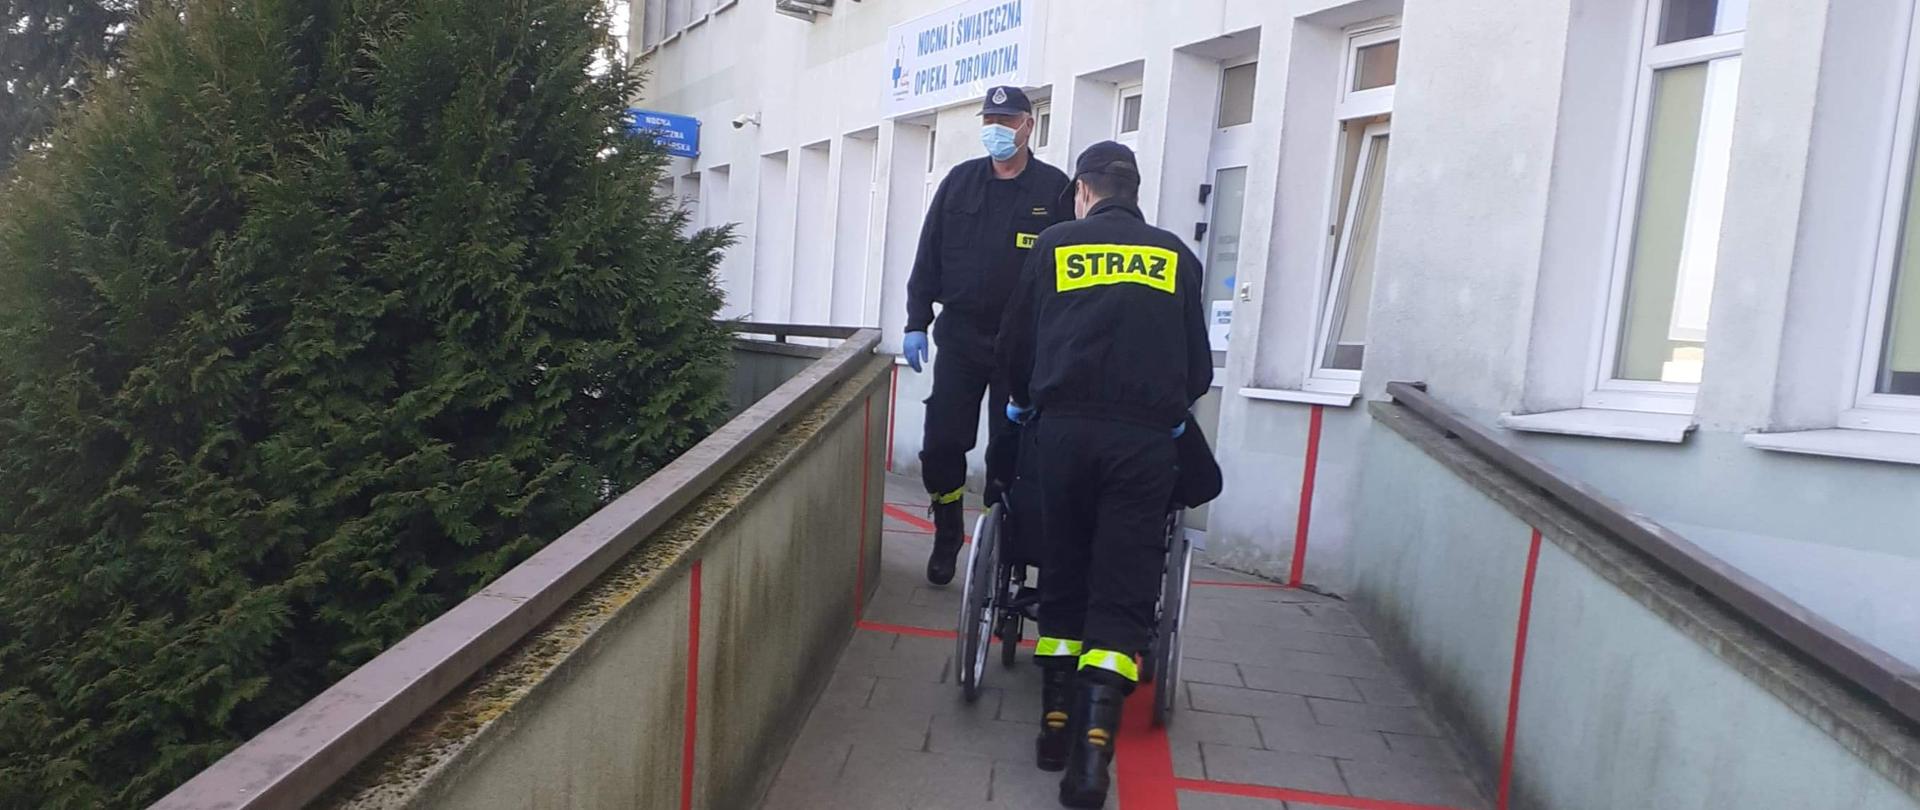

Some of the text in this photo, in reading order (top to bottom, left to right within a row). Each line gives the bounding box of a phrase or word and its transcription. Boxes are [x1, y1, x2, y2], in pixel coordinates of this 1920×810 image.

[917, 0, 1022, 57] NOCNA i ŚWIĄTECZNA
[914, 64, 947, 96] OPIEKA
[953, 44, 1019, 86] ZDROWOTNA
